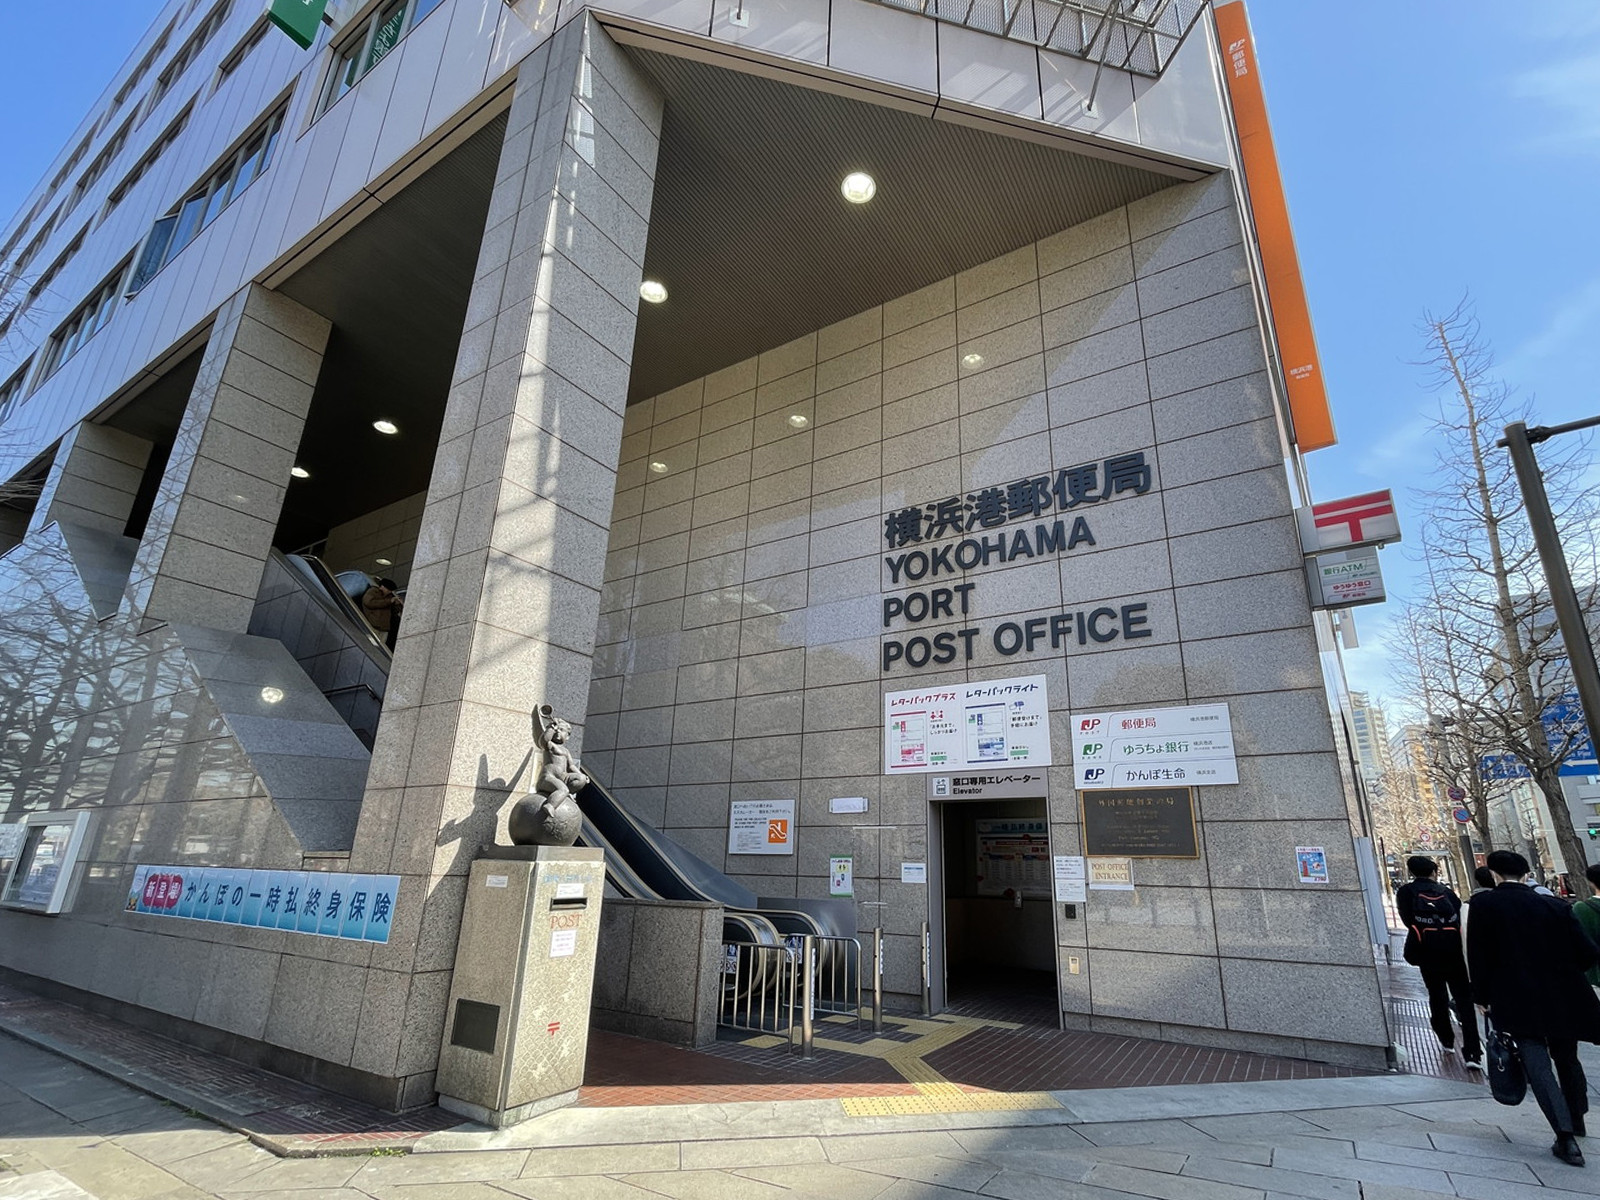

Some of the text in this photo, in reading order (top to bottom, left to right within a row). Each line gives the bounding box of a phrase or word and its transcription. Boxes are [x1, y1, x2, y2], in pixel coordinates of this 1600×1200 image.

[885, 452, 1151, 549] 横浜港郵便局
[885, 516, 1097, 584] YOKOHAMA
[883, 582, 976, 627] PORT
[883, 602, 1152, 671] POST OFFICE
[965, 684, 1039, 699] レターパックライト
[891, 692, 957, 707] レターパックプラス
[1121, 717, 1157, 730] 郵便局
[1123, 741, 1190, 756] ゆうちょ銀行
[952, 775, 1041, 787] 窓口専用エレベーター
[1126, 767, 1186, 782] かんぽ生命
[952, 787, 983, 795] Elevator
[1092, 862, 1129, 871] POST OFFICE
[1095, 872, 1129, 881] ENTRANCE
[184, 881, 392, 924] かんぽの一時払終身保険
[549, 913, 583, 929] POST
